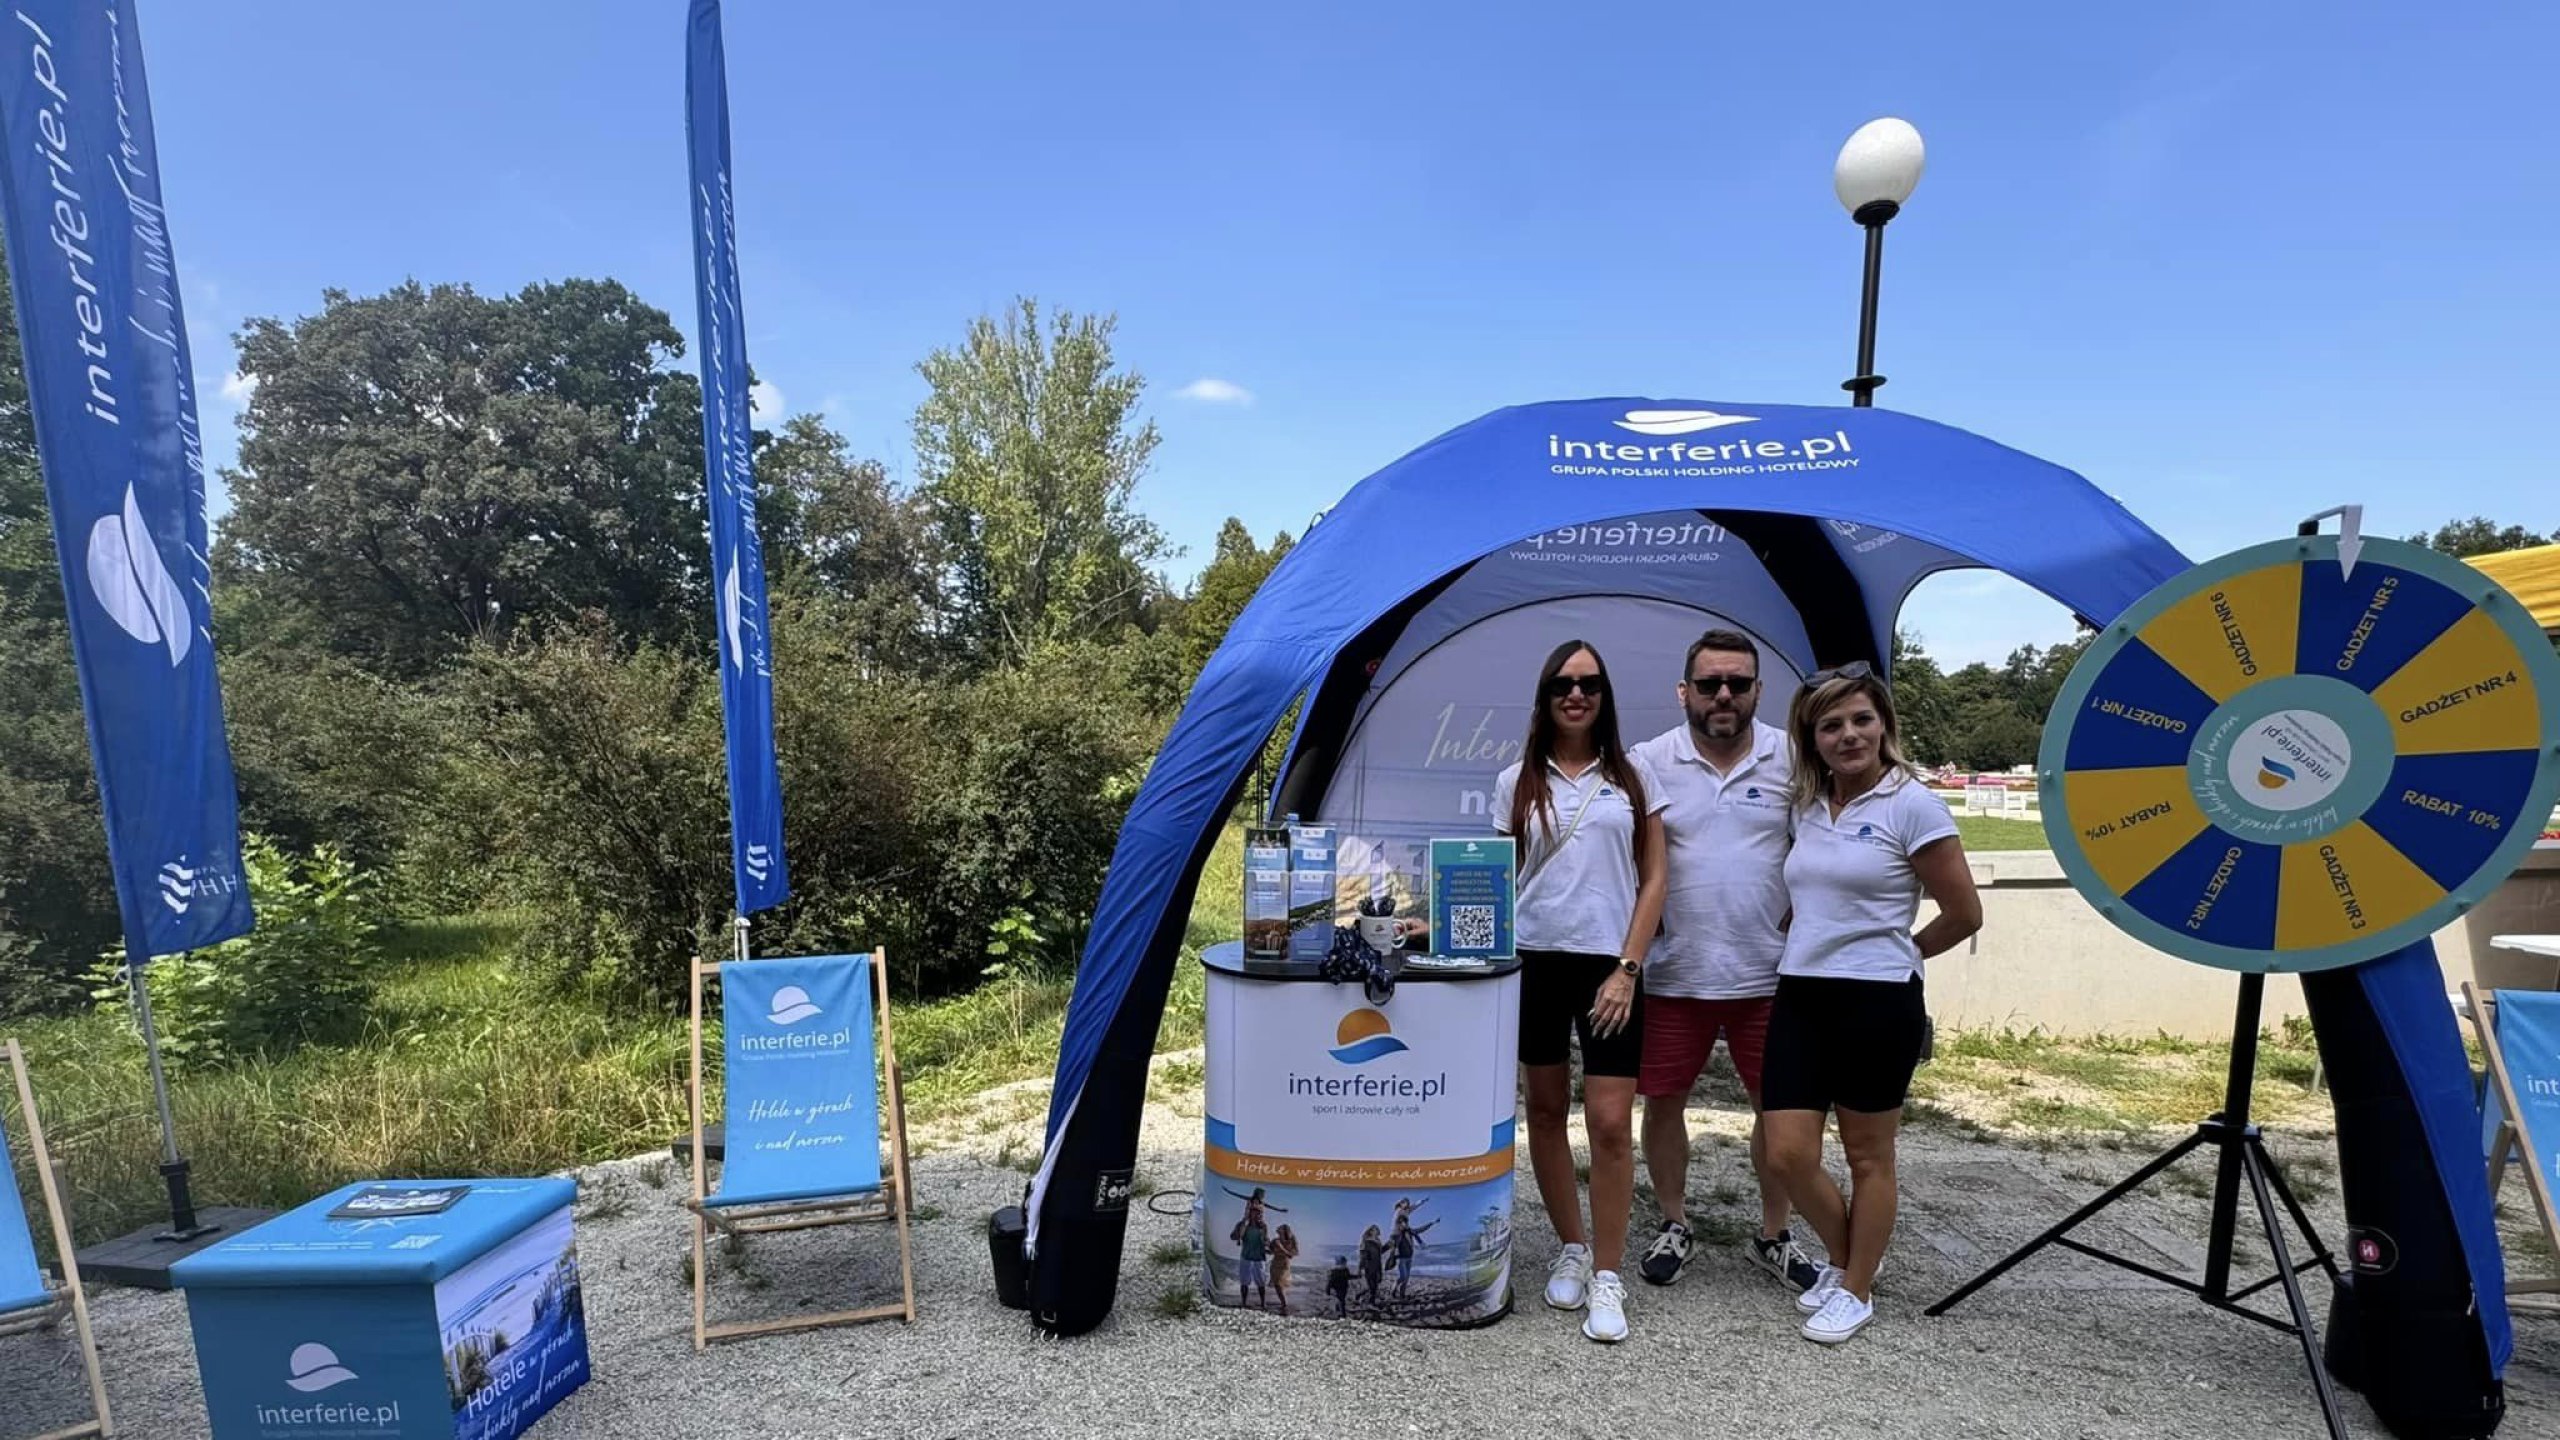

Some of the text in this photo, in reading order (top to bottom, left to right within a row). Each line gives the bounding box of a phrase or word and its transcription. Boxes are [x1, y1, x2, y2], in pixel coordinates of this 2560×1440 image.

[16, 10, 120, 424] interferie.pl
[1549, 430, 1852, 461] interferie.pl
[1550, 458, 1860, 477] GRUPA POLSKI HOLDING HOTELOWY
[2209, 591, 2258, 677] GADŻET NR 6
[2336, 575, 2400, 672] GADŻET NR 5
[2090, 695, 2187, 734] GADŻET NR 1
[2400, 670, 2518, 724] GADŻET NR 4
[2261, 725, 2333, 784] interferie.pl
[2085, 800, 2172, 841] RABAT 10%
[2402, 789, 2500, 830] RABAT 10%
[2186, 846, 2243, 930] GADŻET NR 2
[2319, 844, 2367, 930] GADŻET NR 3
[740, 1027, 851, 1051] interferie.pl
[1289, 1072, 1446, 1102] interferie.pl
[1312, 1105, 1337, 1115] sport
[1345, 1105, 1382, 1115] zdrowie
[1385, 1105, 1402, 1117] cały
[1405, 1105, 1420, 1115] rok
[1237, 1159, 1489, 1181] Hotele w górach i nad morzem
[466, 1359, 526, 1419] Hotele
[256, 1399, 401, 1427] interferie.pl
